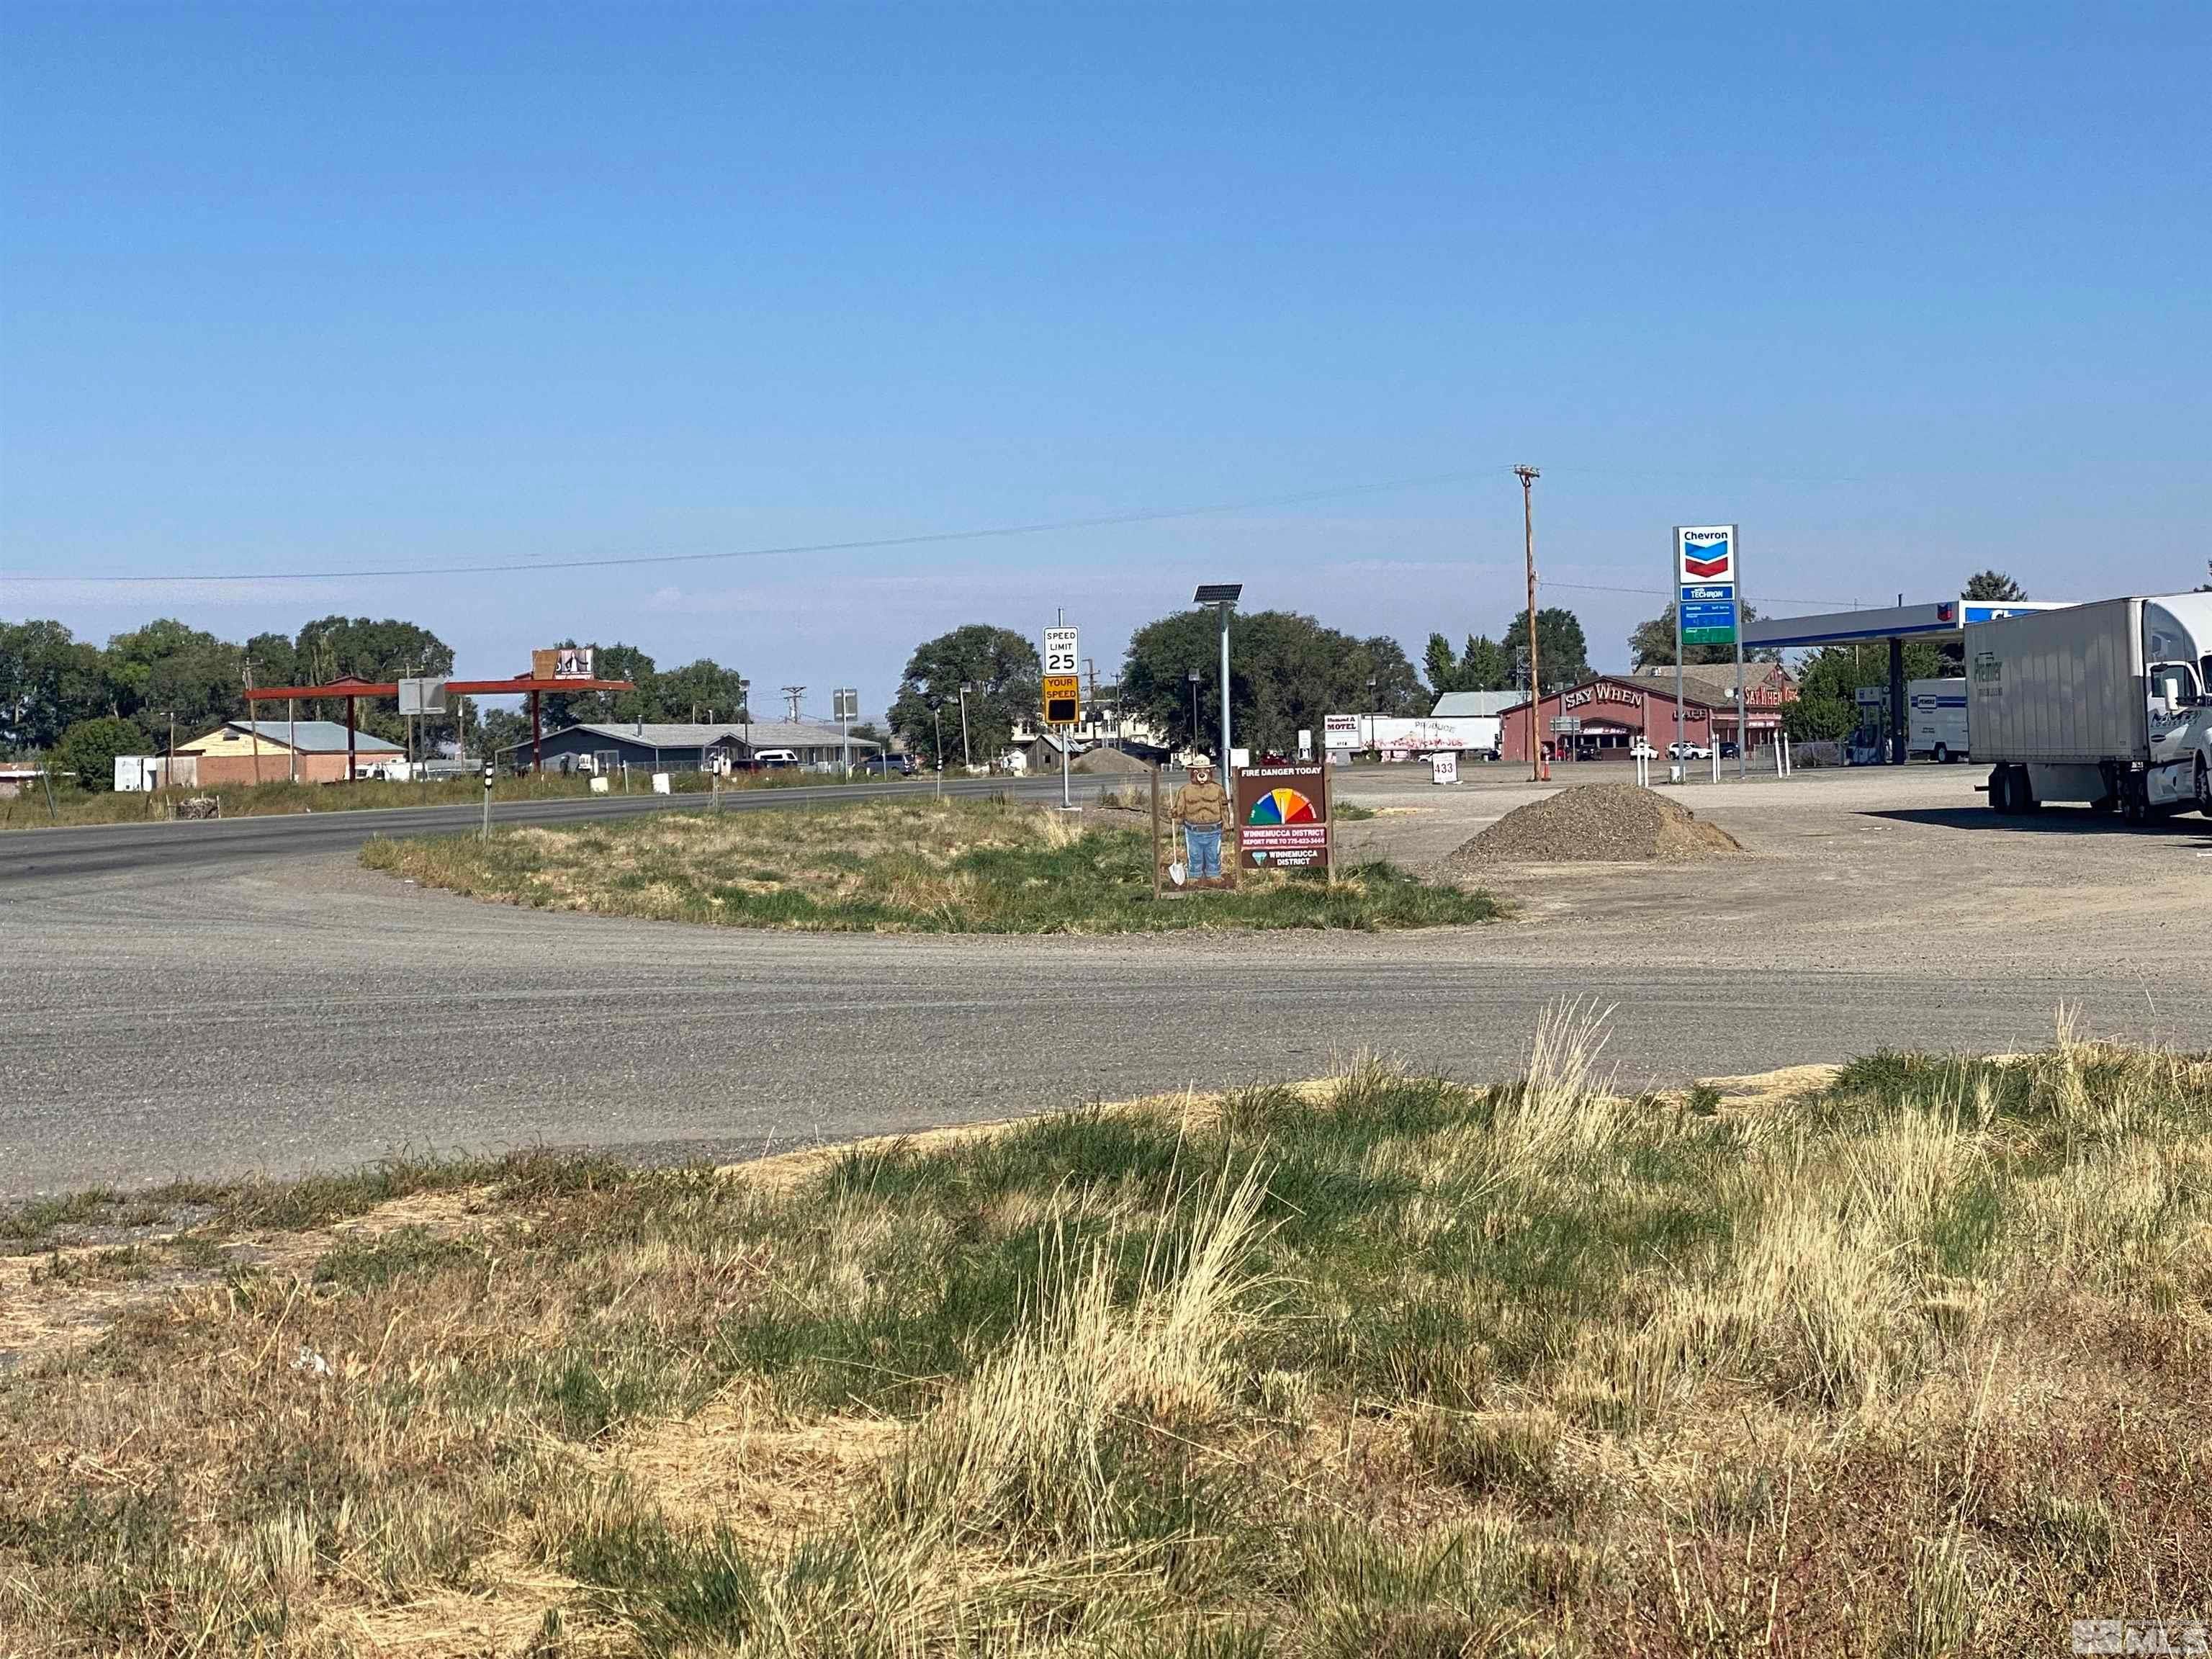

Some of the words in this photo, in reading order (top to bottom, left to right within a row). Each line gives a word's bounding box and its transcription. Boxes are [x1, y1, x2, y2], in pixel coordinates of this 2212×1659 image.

[1684, 531, 1728, 541] Chevron
[1691, 590, 1723, 599] TECHRON
[1048, 655, 1074, 670] 25
[1565, 689, 1593, 709] SAY
[1595, 682, 1642, 706] WHEN
[1745, 687, 1760, 705] SAY
[1241, 768, 1260, 777] FIRE
[1261, 768, 1295, 776] DANGER
[1295, 766, 1322, 775] TODAY
[1434, 763, 1453, 774] 433
